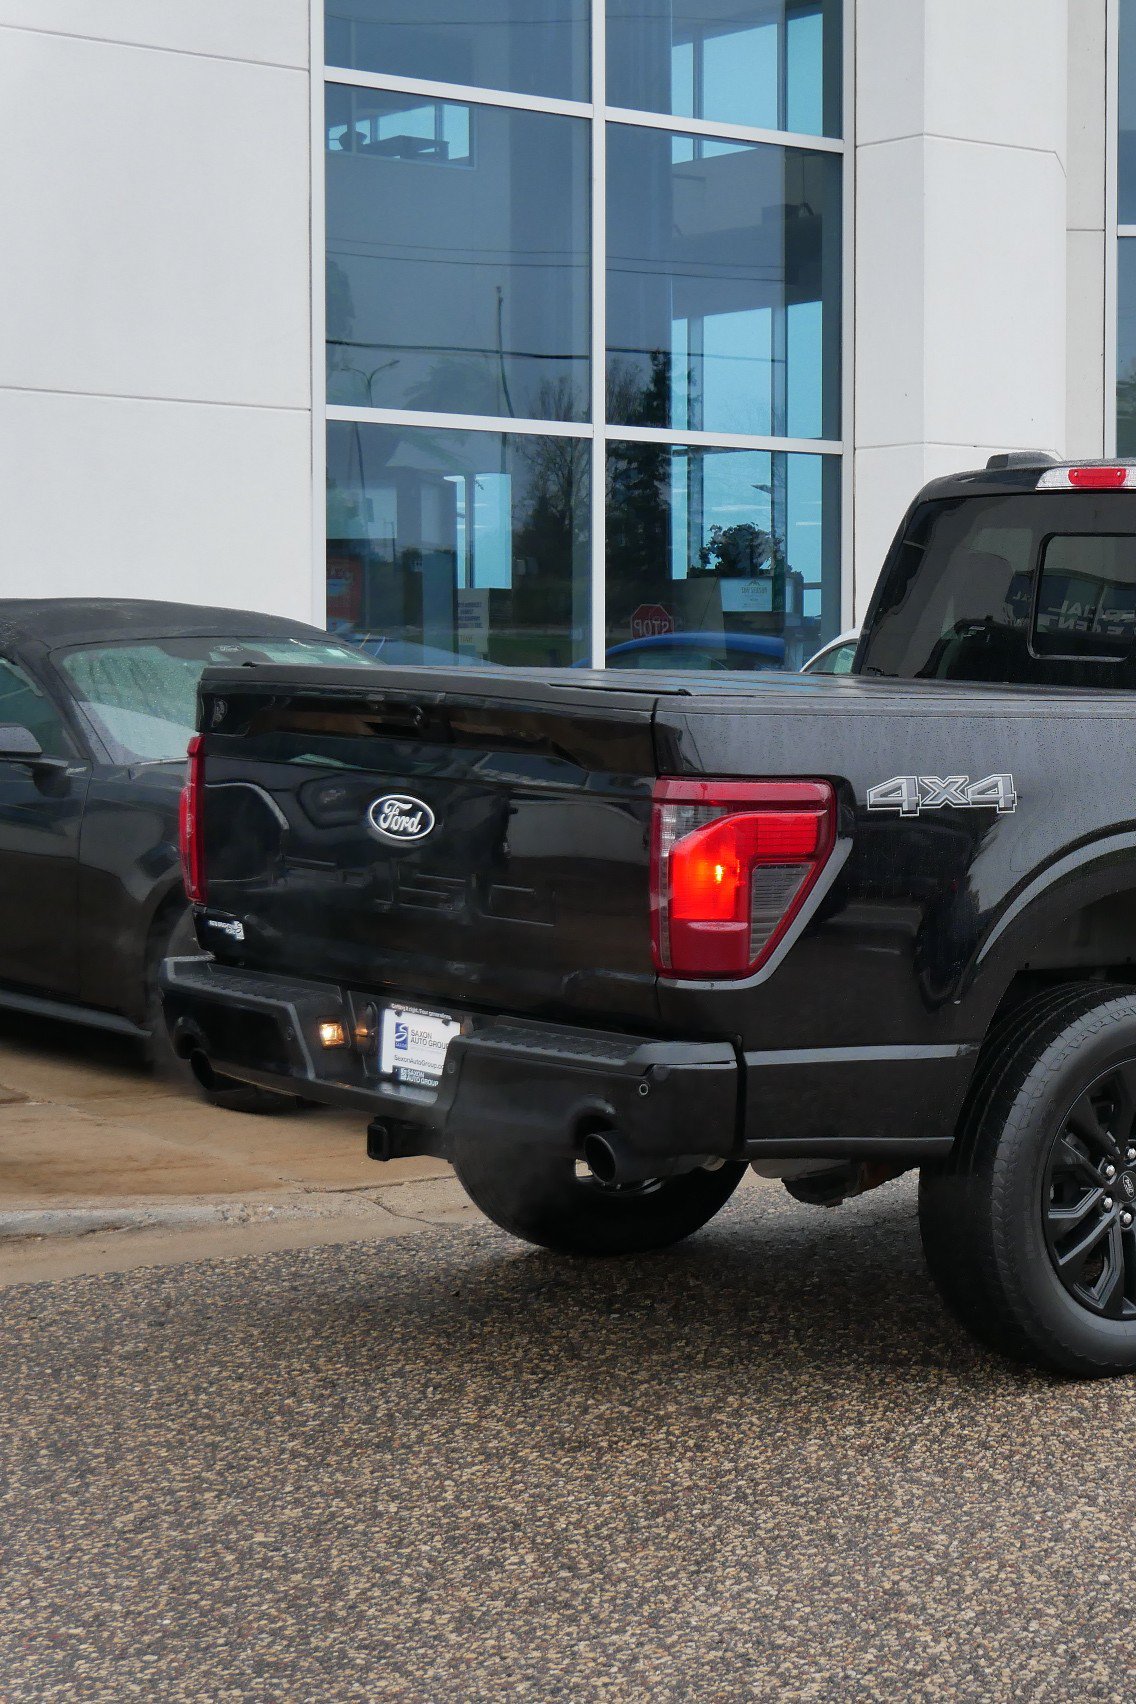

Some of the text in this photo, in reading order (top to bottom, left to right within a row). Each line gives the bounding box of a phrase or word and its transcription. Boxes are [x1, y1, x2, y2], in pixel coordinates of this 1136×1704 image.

[380, 800, 423, 833] Ford
[411, 1029, 432, 1039] SAXON
[410, 1037, 428, 1046] AUTO
[407, 1068, 425, 1079] SAXON
[420, 1078, 439, 1087] GROUP
